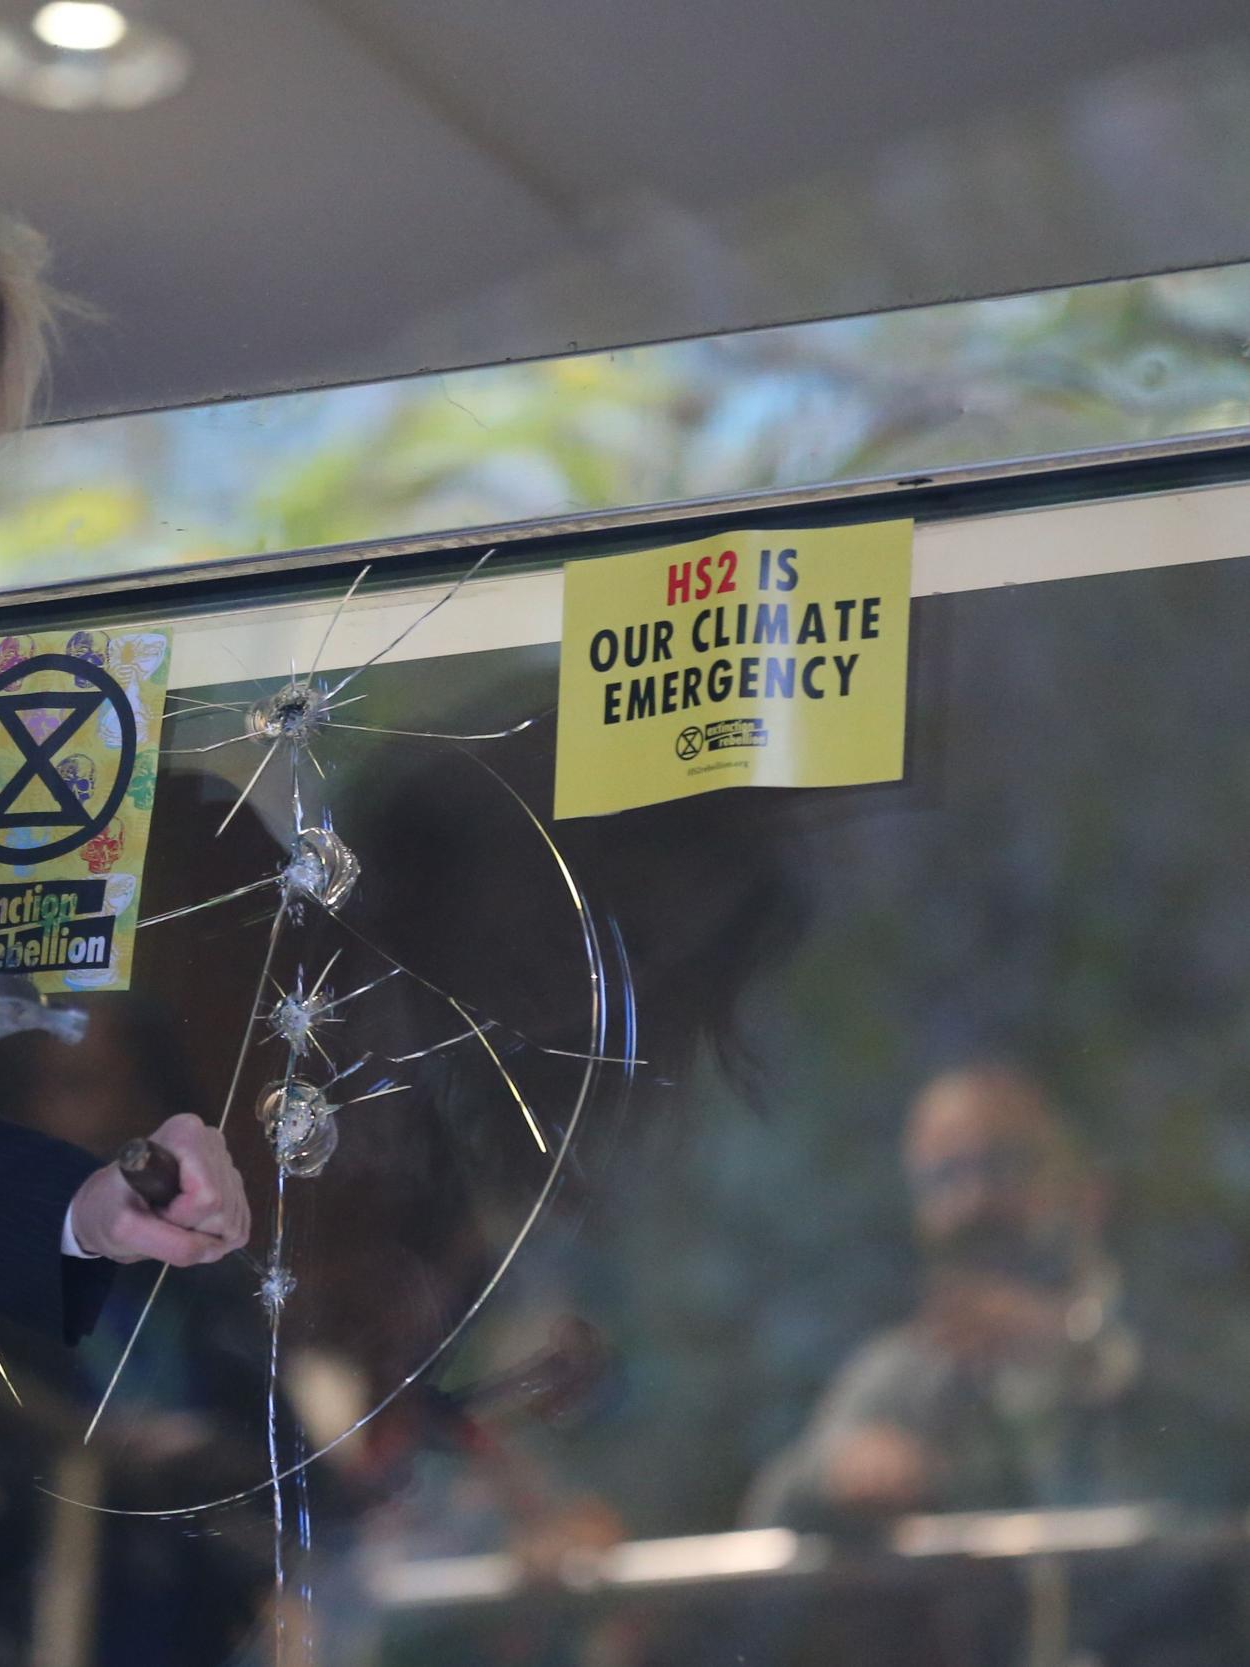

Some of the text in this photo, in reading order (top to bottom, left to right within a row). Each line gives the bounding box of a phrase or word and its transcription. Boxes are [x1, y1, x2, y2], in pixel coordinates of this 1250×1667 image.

[667, 548, 799, 606] HS2 IS
[589, 597, 881, 672] OUR CLIMATE
[603, 654, 860, 725] EMERGENCY
